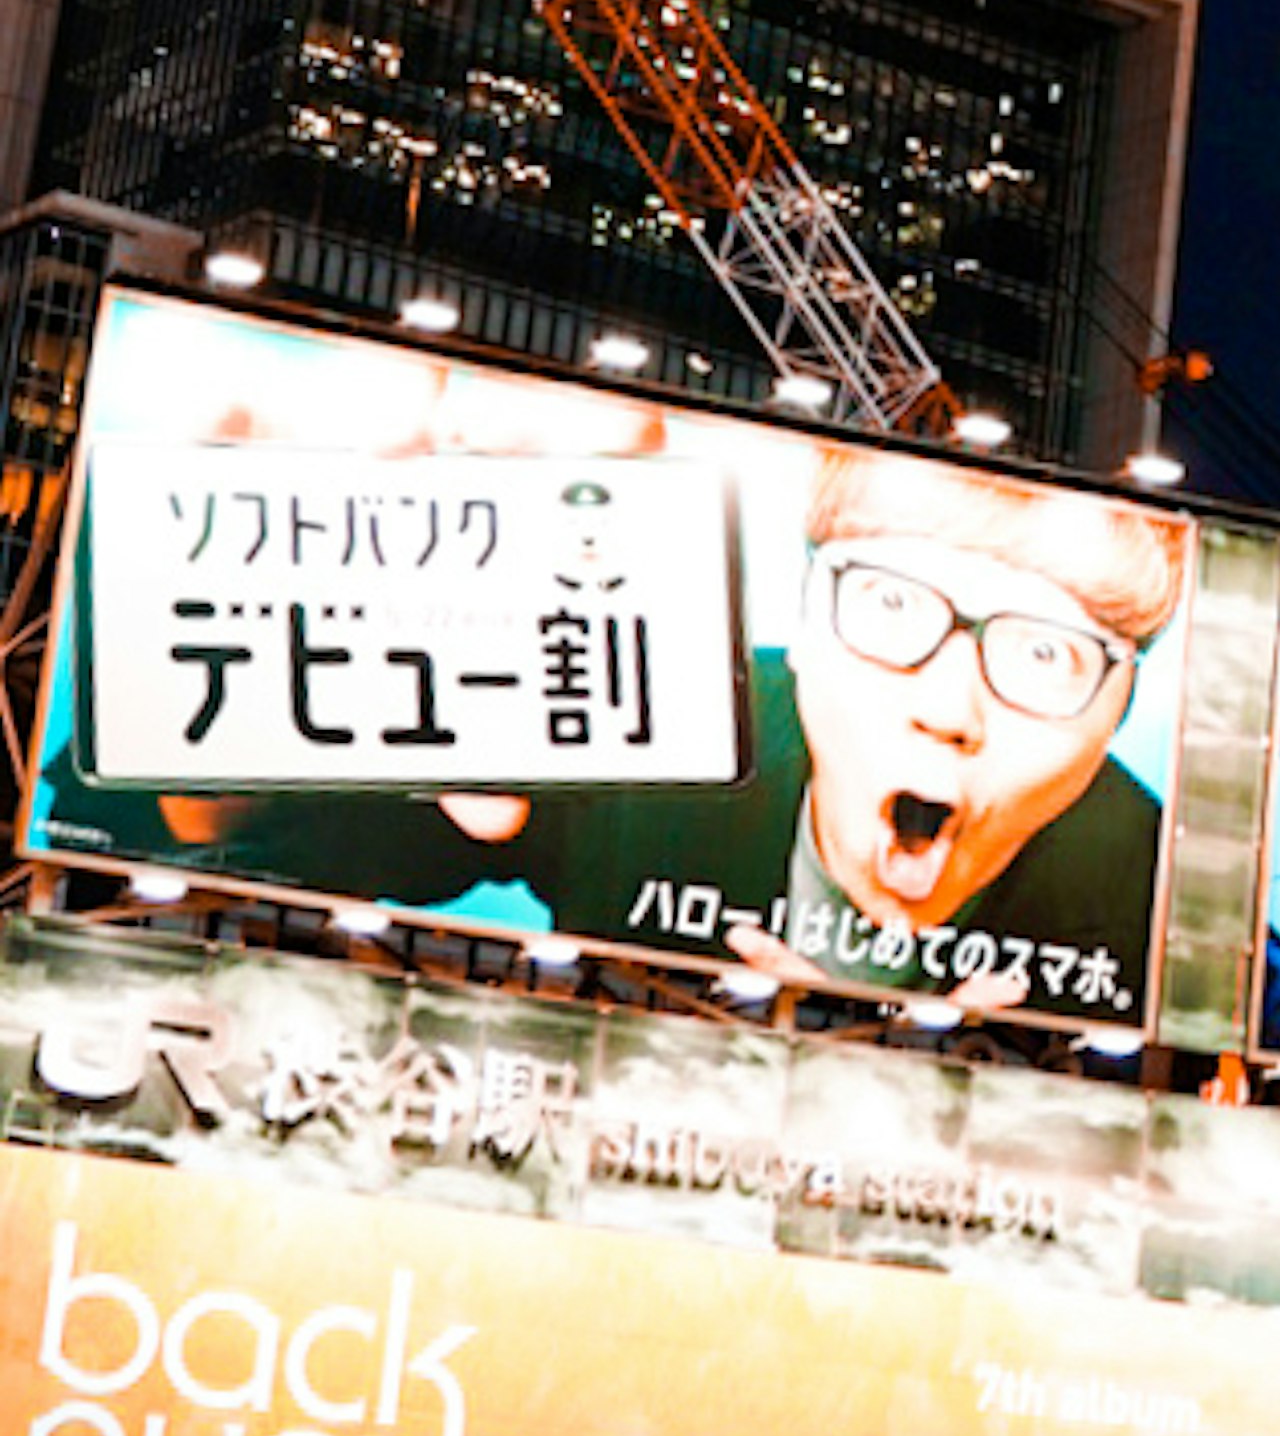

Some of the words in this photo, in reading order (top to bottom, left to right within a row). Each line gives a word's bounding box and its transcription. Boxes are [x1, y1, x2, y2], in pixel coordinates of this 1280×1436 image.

[168, 487, 505, 573] ソフトバンク
[168, 599, 653, 750] デビュー割
[40, 1220, 478, 1433] back
[1059, 1374, 1202, 1433] album
